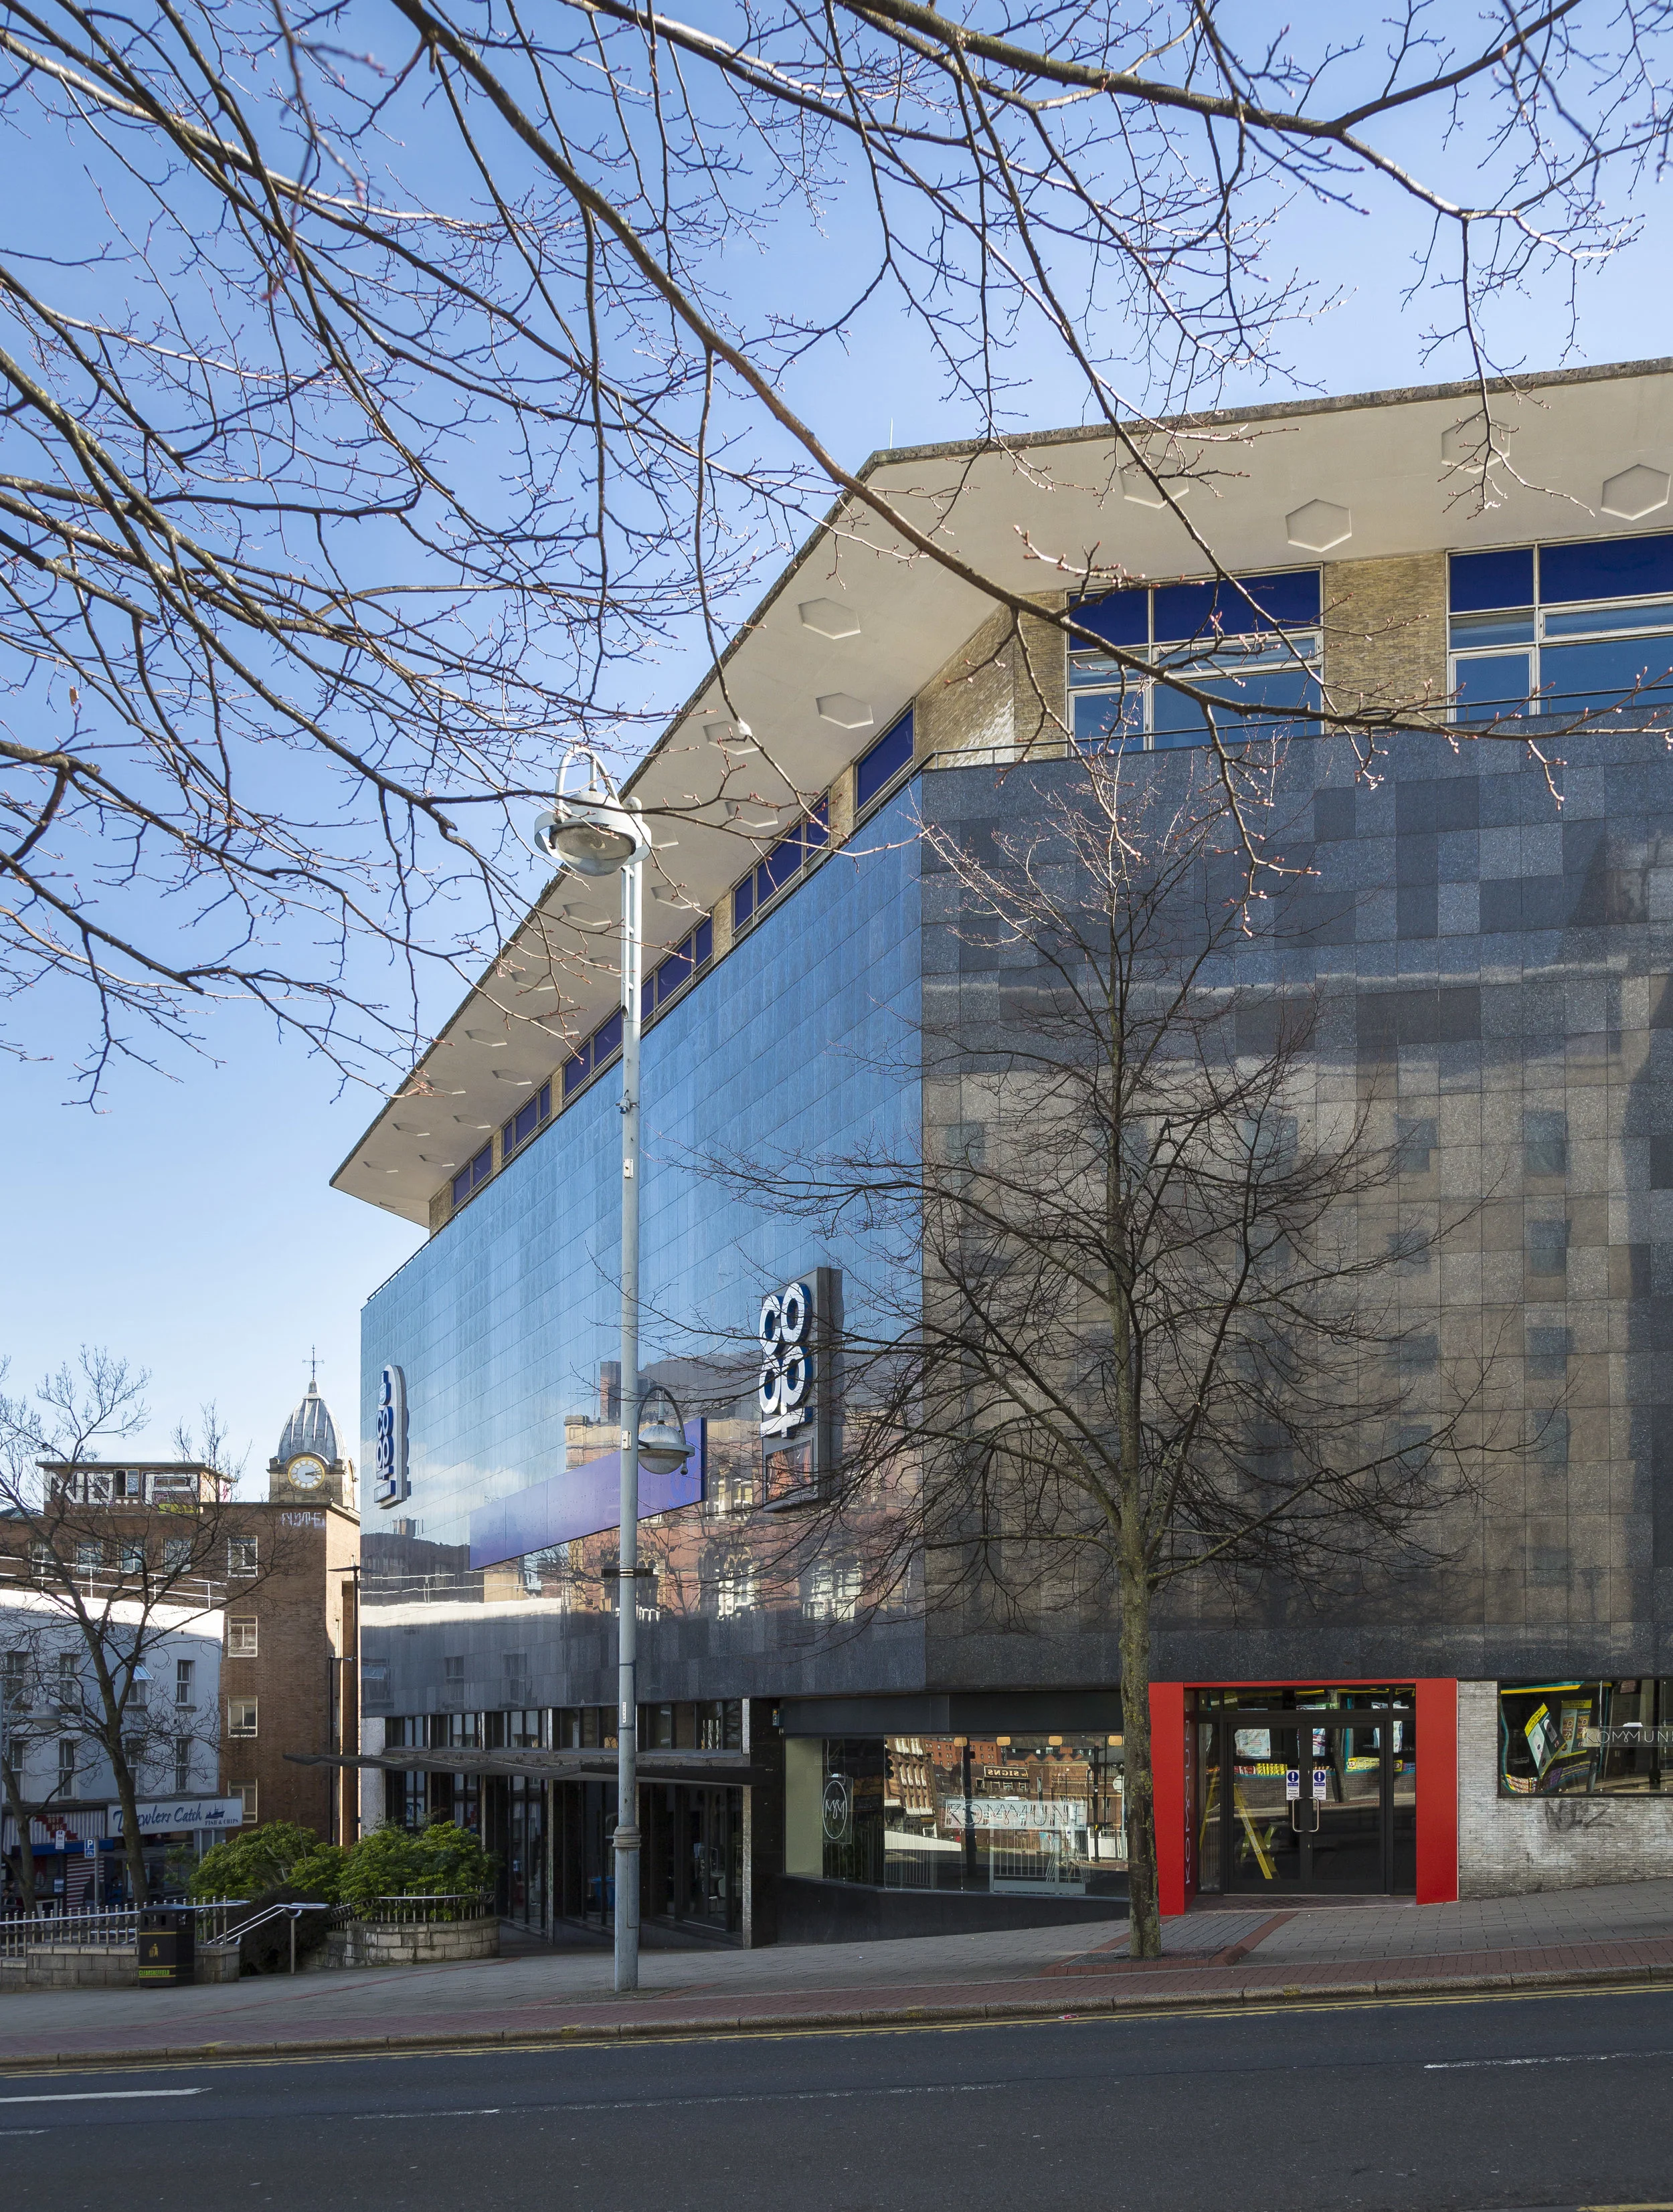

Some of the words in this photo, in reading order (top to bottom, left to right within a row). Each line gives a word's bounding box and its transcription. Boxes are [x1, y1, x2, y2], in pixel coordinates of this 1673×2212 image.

[1586, 1730, 1673, 1743] KOMMUN
[113, 1804, 171, 1833] Tawlers
[173, 1802, 203, 1823] Catch
[946, 1803, 1086, 1827] KOMMUNE
[87, 1839, 93, 1848] P
